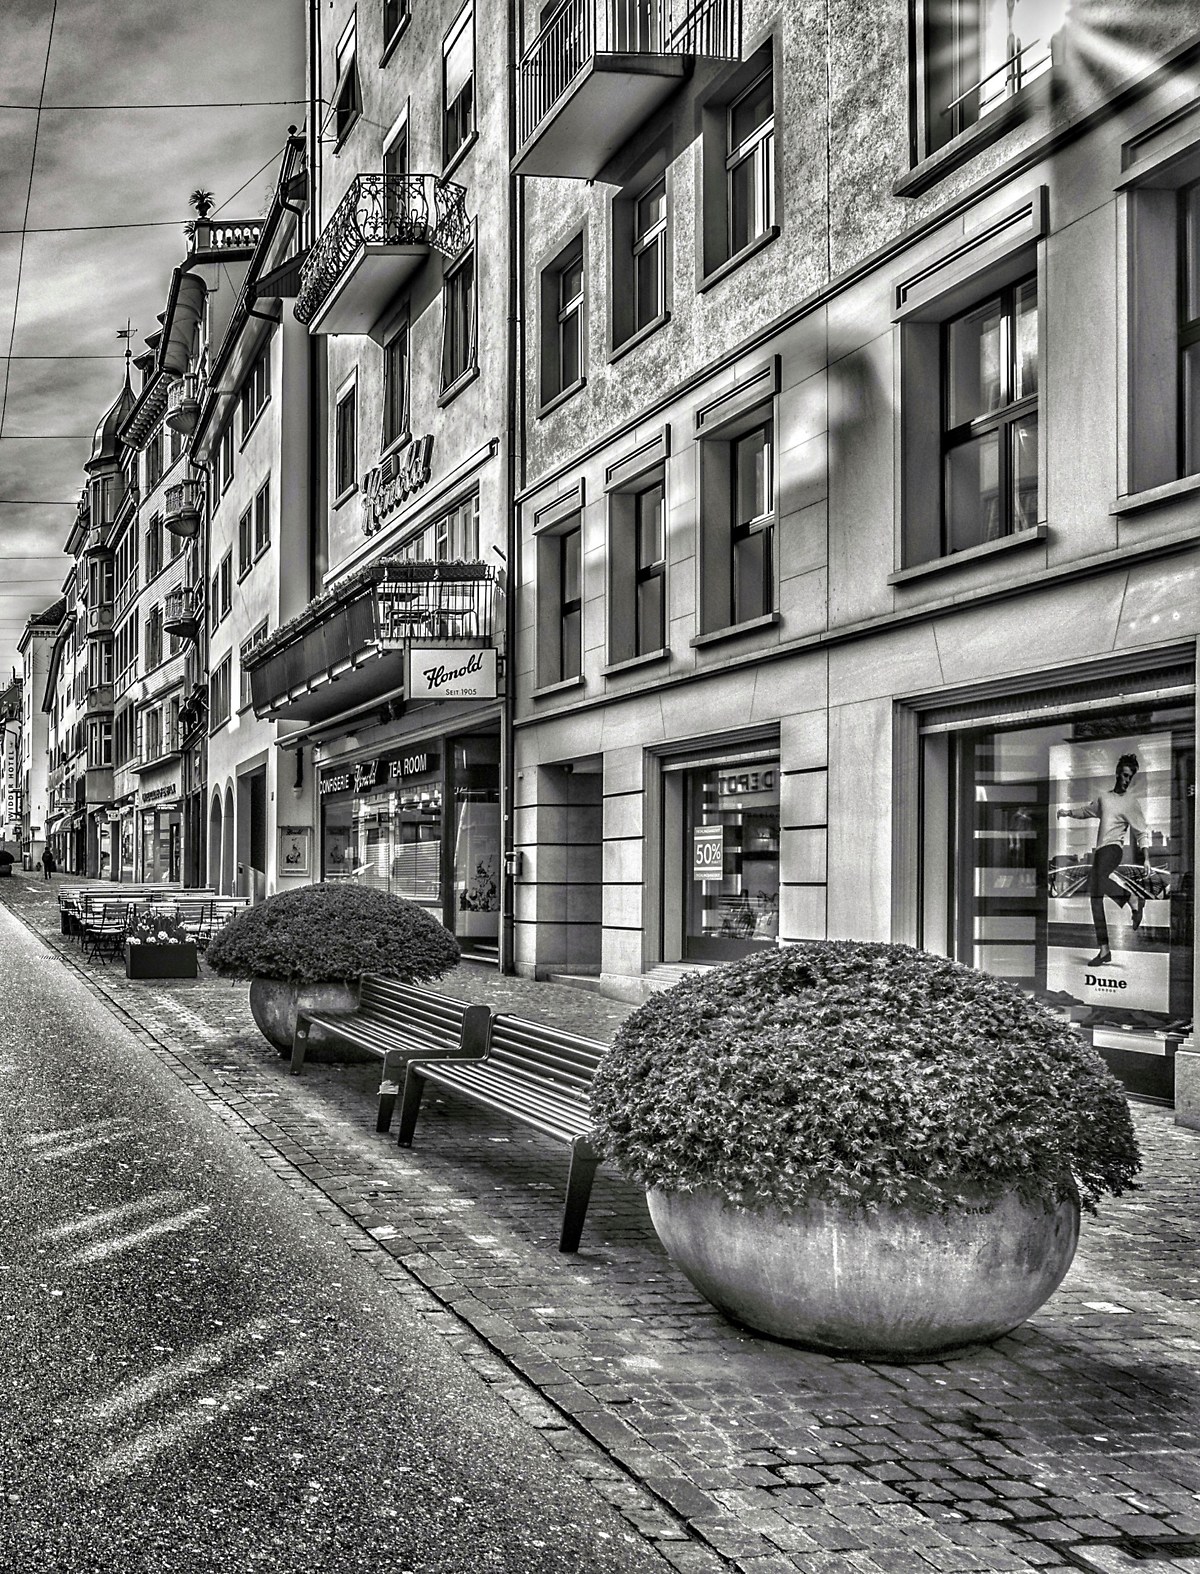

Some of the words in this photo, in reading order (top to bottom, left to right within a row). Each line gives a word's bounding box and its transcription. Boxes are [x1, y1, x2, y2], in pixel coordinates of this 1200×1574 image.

[423, 652, 483, 689] Honold
[445, 688, 460, 696] SEIT
[460, 688, 477, 696] 1905
[319, 774, 349, 795] CONFISERIE
[388, 761, 402, 778] TEA
[403, 753, 427, 774] ROOM
[696, 843, 721, 865] 50%
[1084, 974, 1128, 989] Dune
